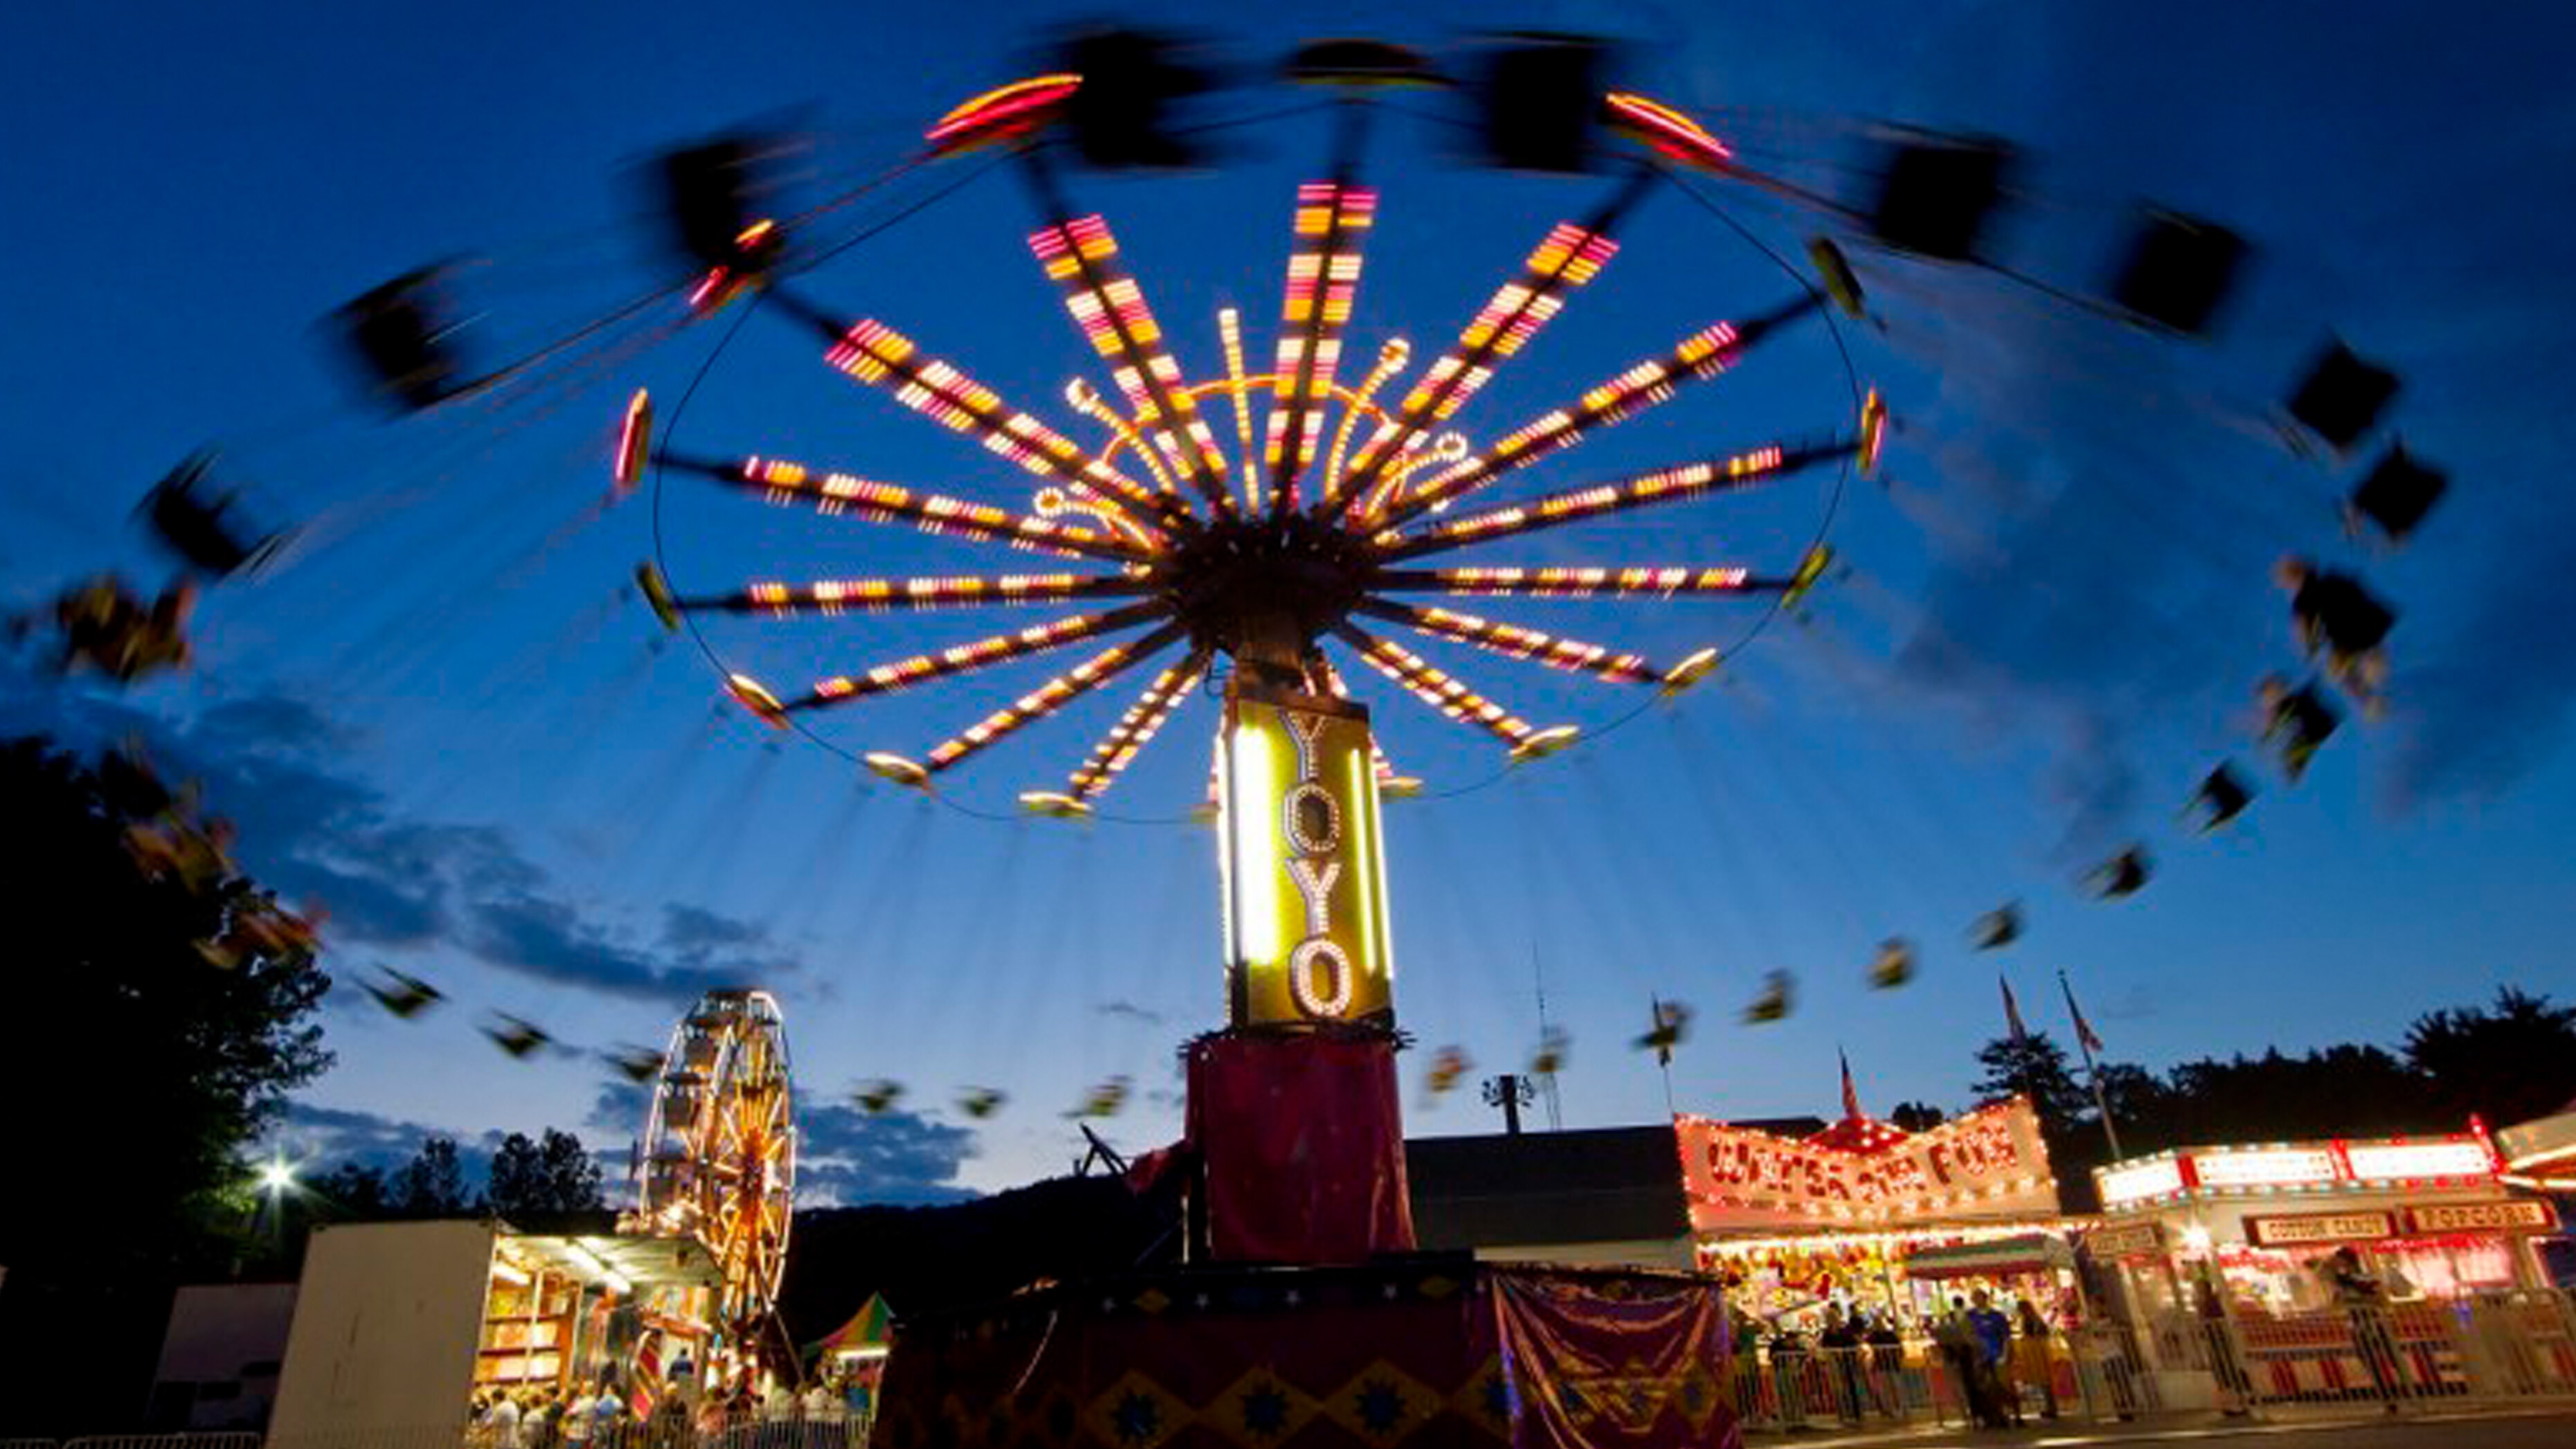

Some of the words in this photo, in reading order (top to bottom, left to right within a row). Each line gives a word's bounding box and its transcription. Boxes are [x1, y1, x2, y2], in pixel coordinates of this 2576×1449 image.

[1279, 708, 1352, 1018] YOYO
[1929, 1123, 2019, 1186] FUN
[2424, 1205, 2537, 1229] POPCORN
